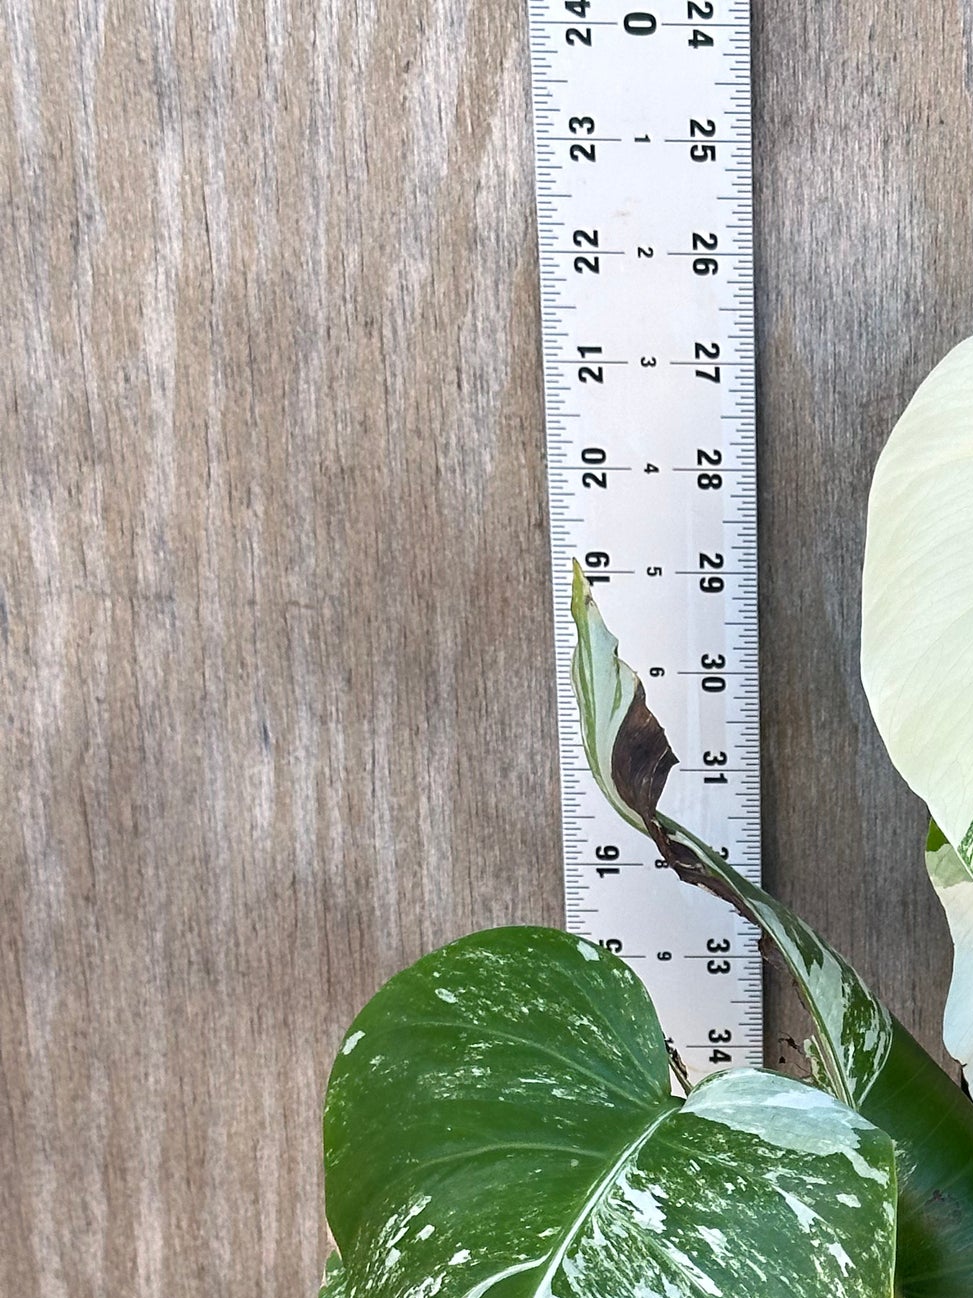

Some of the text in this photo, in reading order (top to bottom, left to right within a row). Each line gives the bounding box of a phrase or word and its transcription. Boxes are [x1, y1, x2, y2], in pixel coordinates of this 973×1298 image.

[565, 0, 592, 46] 24
[623, 12, 657, 36] 0
[687, 1, 714, 49] 24
[568, 116, 596, 162] 23
[634, 134, 651, 142] 1
[690, 119, 716, 162] 25
[573, 230, 600, 274] 22
[637, 247, 654, 258] 2
[692, 233, 719, 275] 26
[577, 346, 603, 384] 21
[641, 357, 656, 367] 3
[695, 343, 720, 384] 27
[581, 448, 607, 489] 20
[644, 463, 660, 474] 4
[697, 449, 723, 490] 28
[585, 552, 610, 587] 19
[647, 567, 662, 576] 5
[699, 553, 724, 593] 29
[649, 667, 665, 677] 6
[701, 654, 726, 693] 30
[703, 751, 728, 784] 31
[595, 845, 620, 878] 16
[655, 859, 669, 869] 8
[657, 951, 672, 961] 9
[706, 938, 731, 975] 33
[708, 1029, 732, 1064] 34
